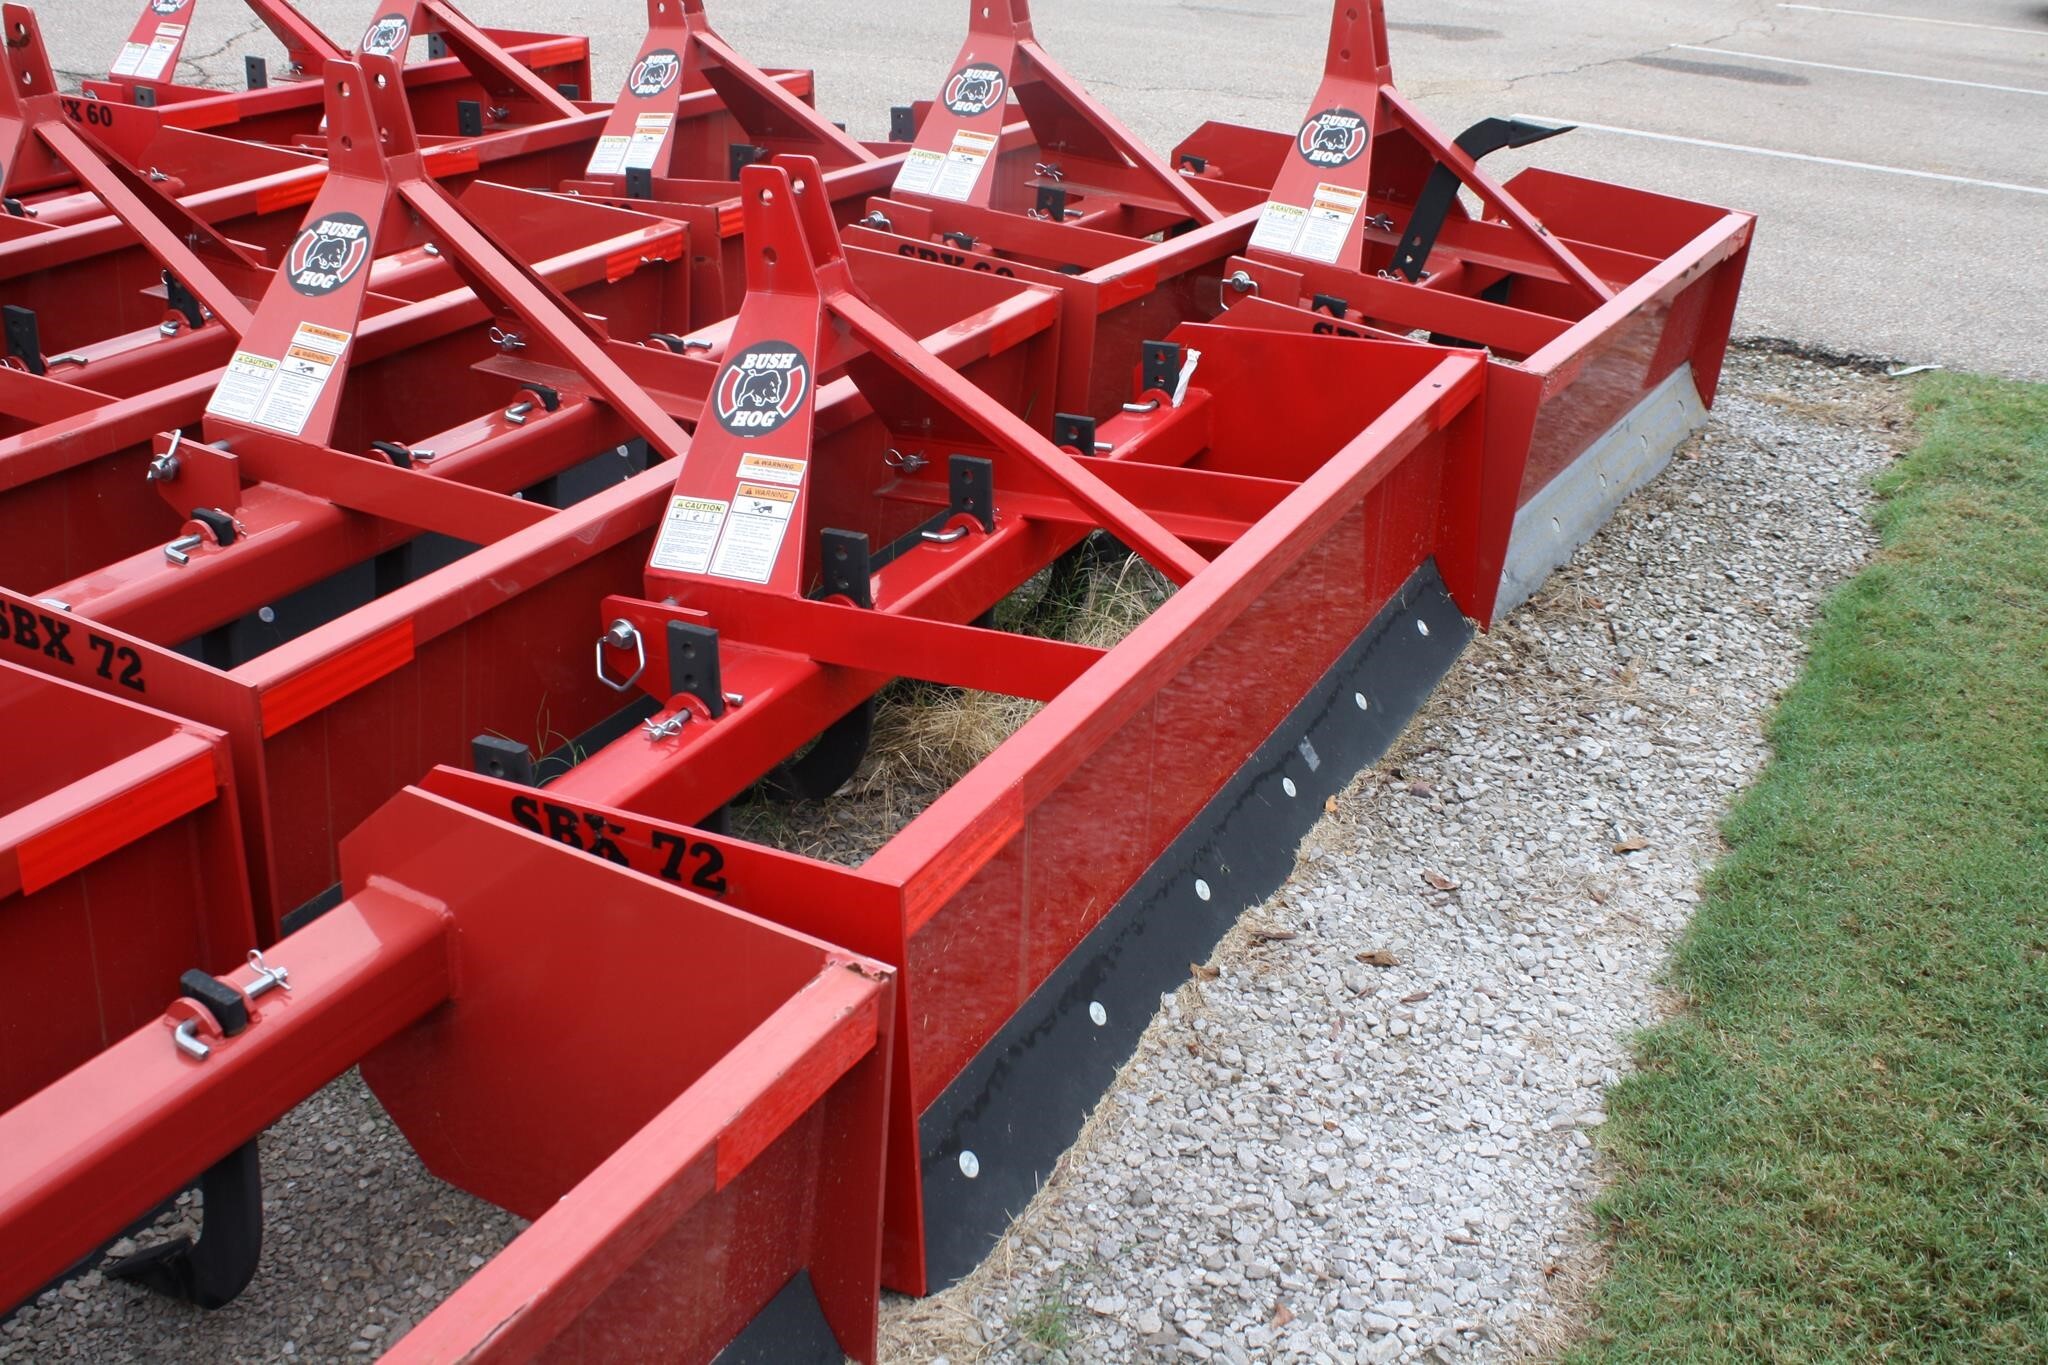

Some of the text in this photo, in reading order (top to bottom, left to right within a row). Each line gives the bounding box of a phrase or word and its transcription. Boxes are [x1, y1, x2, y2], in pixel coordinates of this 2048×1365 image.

[963, 68, 999, 81] BUSH
[952, 101, 982, 113] HOG
[86, 103, 113, 127] 60
[1318, 114, 1360, 129] BUSH
[1309, 150, 1344, 164] HOG
[316, 220, 364, 238] BUSH
[296, 270, 337, 288] HOG
[243, 355, 275, 368] CAUTION
[741, 353, 797, 369] BUSH
[730, 410, 779, 427] HOG
[760, 460, 795, 470] WARNING
[685, 501, 722, 512] CAUTION
[89, 633, 146, 693] 72
[651, 830, 727, 892] 72
